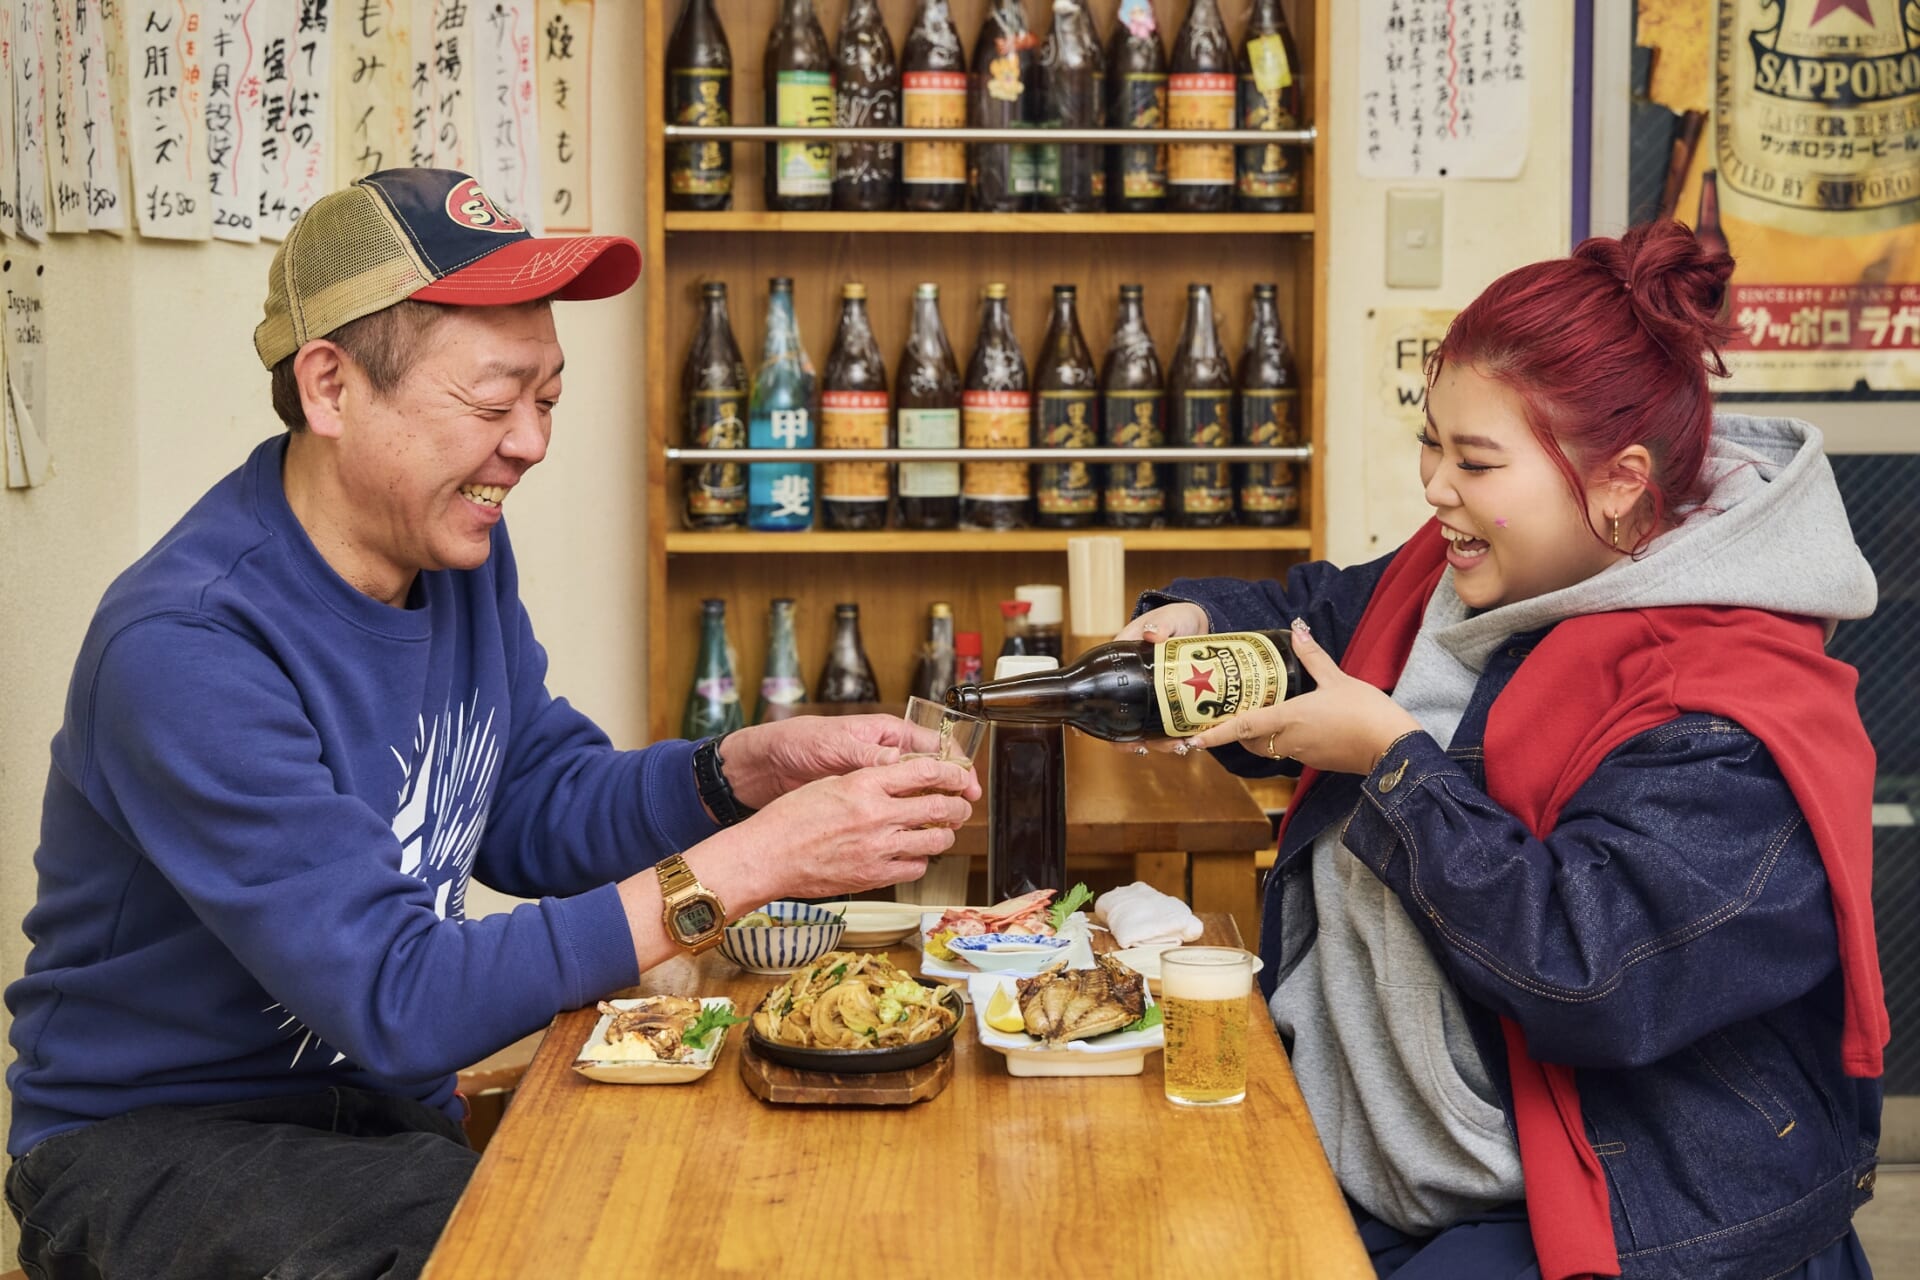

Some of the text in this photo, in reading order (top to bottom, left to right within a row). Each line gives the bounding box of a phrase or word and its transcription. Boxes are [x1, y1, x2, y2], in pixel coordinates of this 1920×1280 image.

[1757, 52, 1920, 99] SAPPORO
[545, 20, 574, 215] 焼きもの
[1761, 133, 1919, 160] サッポロラガービール
[1737, 306, 1850, 347] サッポロ
[1216, 649, 1242, 713] SAPPORO
